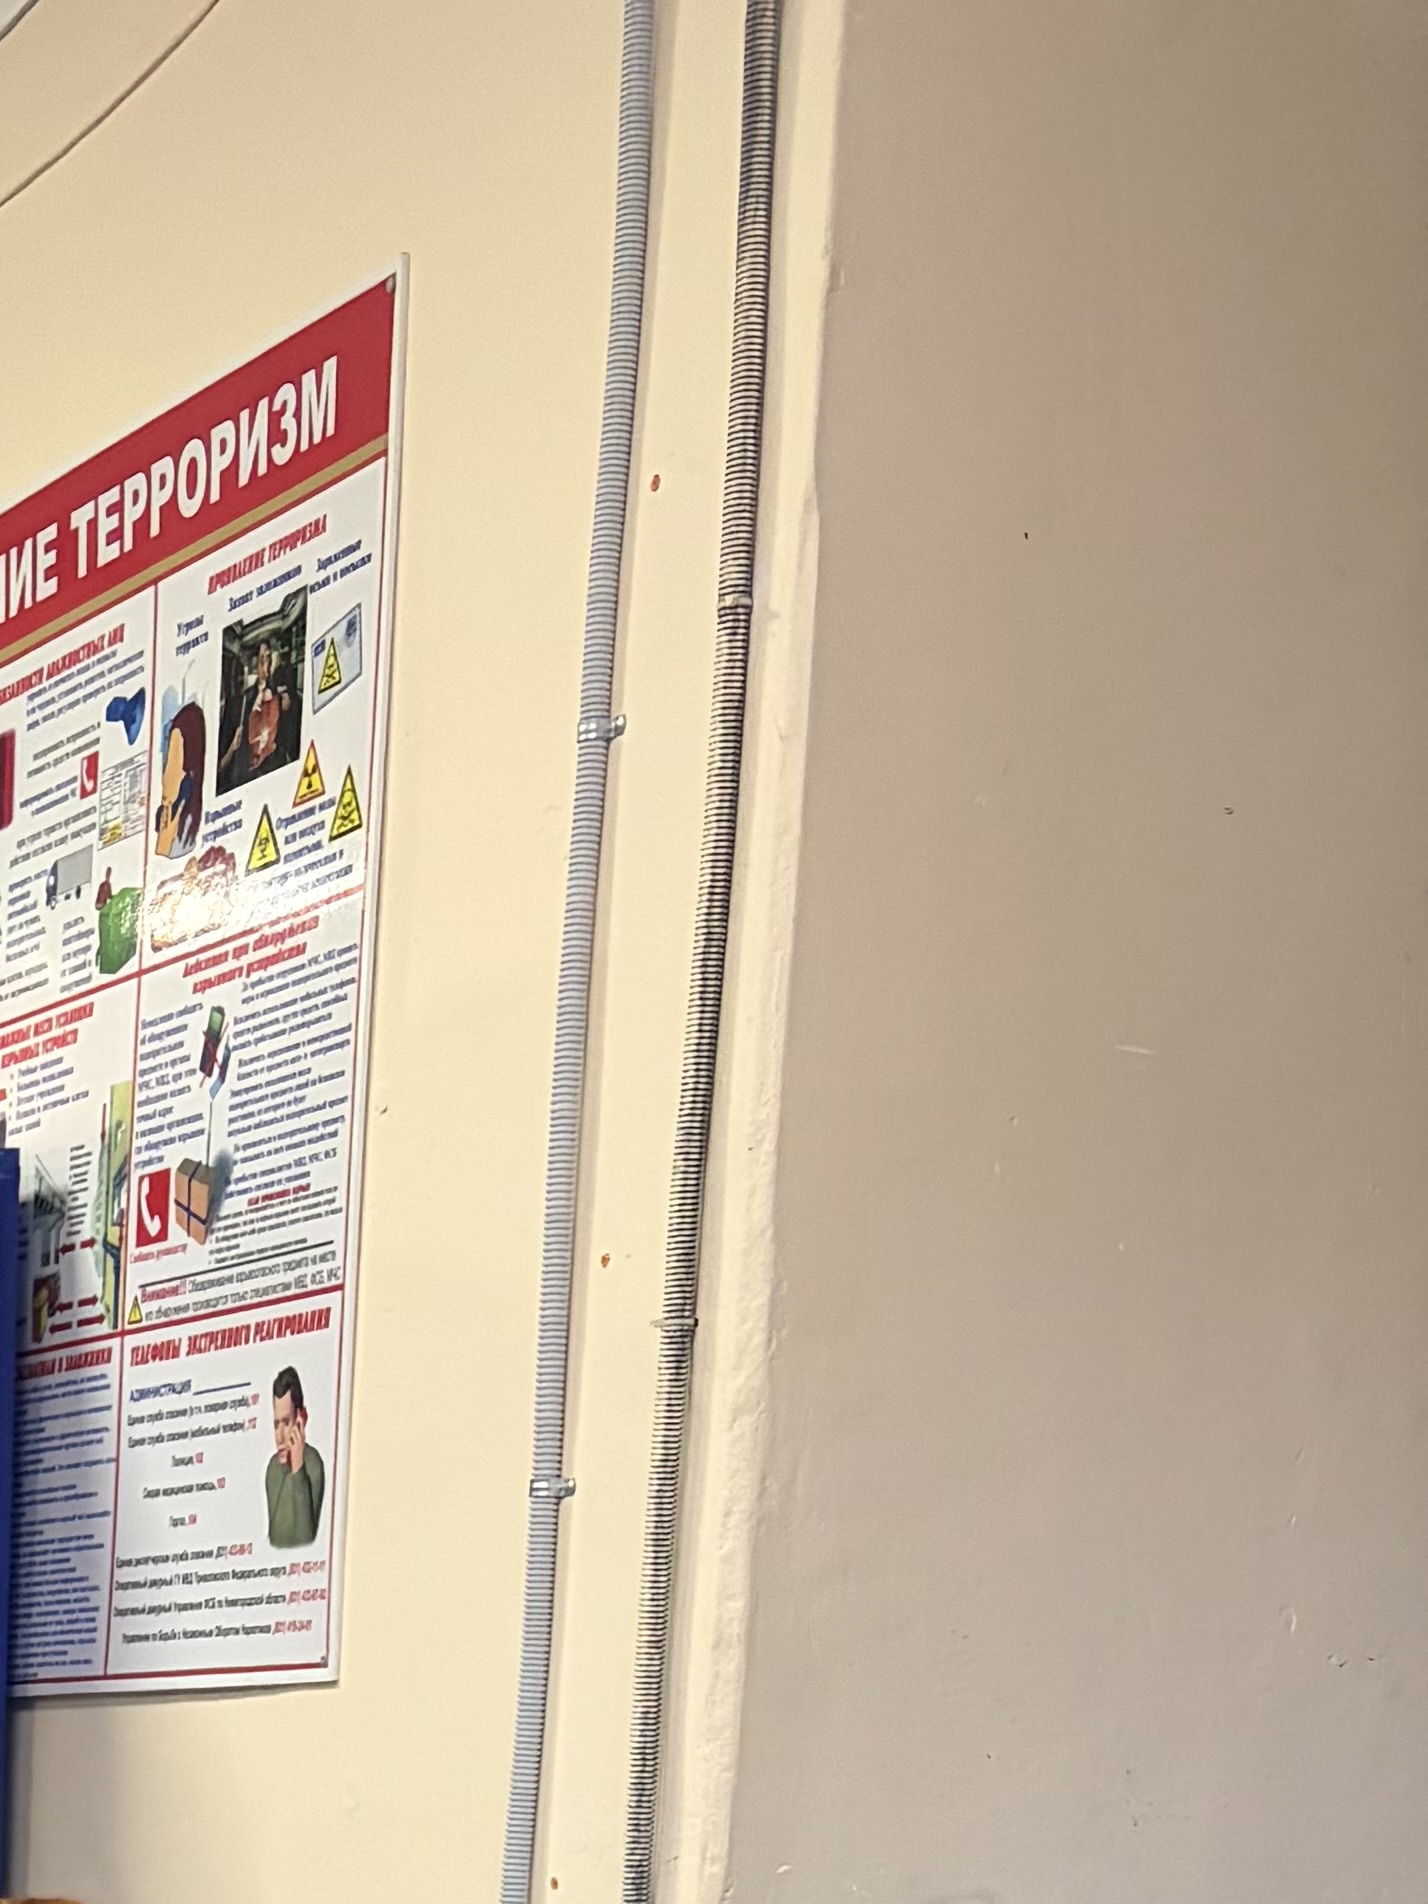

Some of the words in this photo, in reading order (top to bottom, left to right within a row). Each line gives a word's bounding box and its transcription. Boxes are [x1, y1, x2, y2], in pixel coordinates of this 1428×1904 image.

[69, 351, 338, 585] ТЕРРОРИЗМ
[129, 1337, 181, 1367] ТЕЛЕФОНЫ
[253, 1306, 331, 1343] РЕАГИРОВАНИЯ
